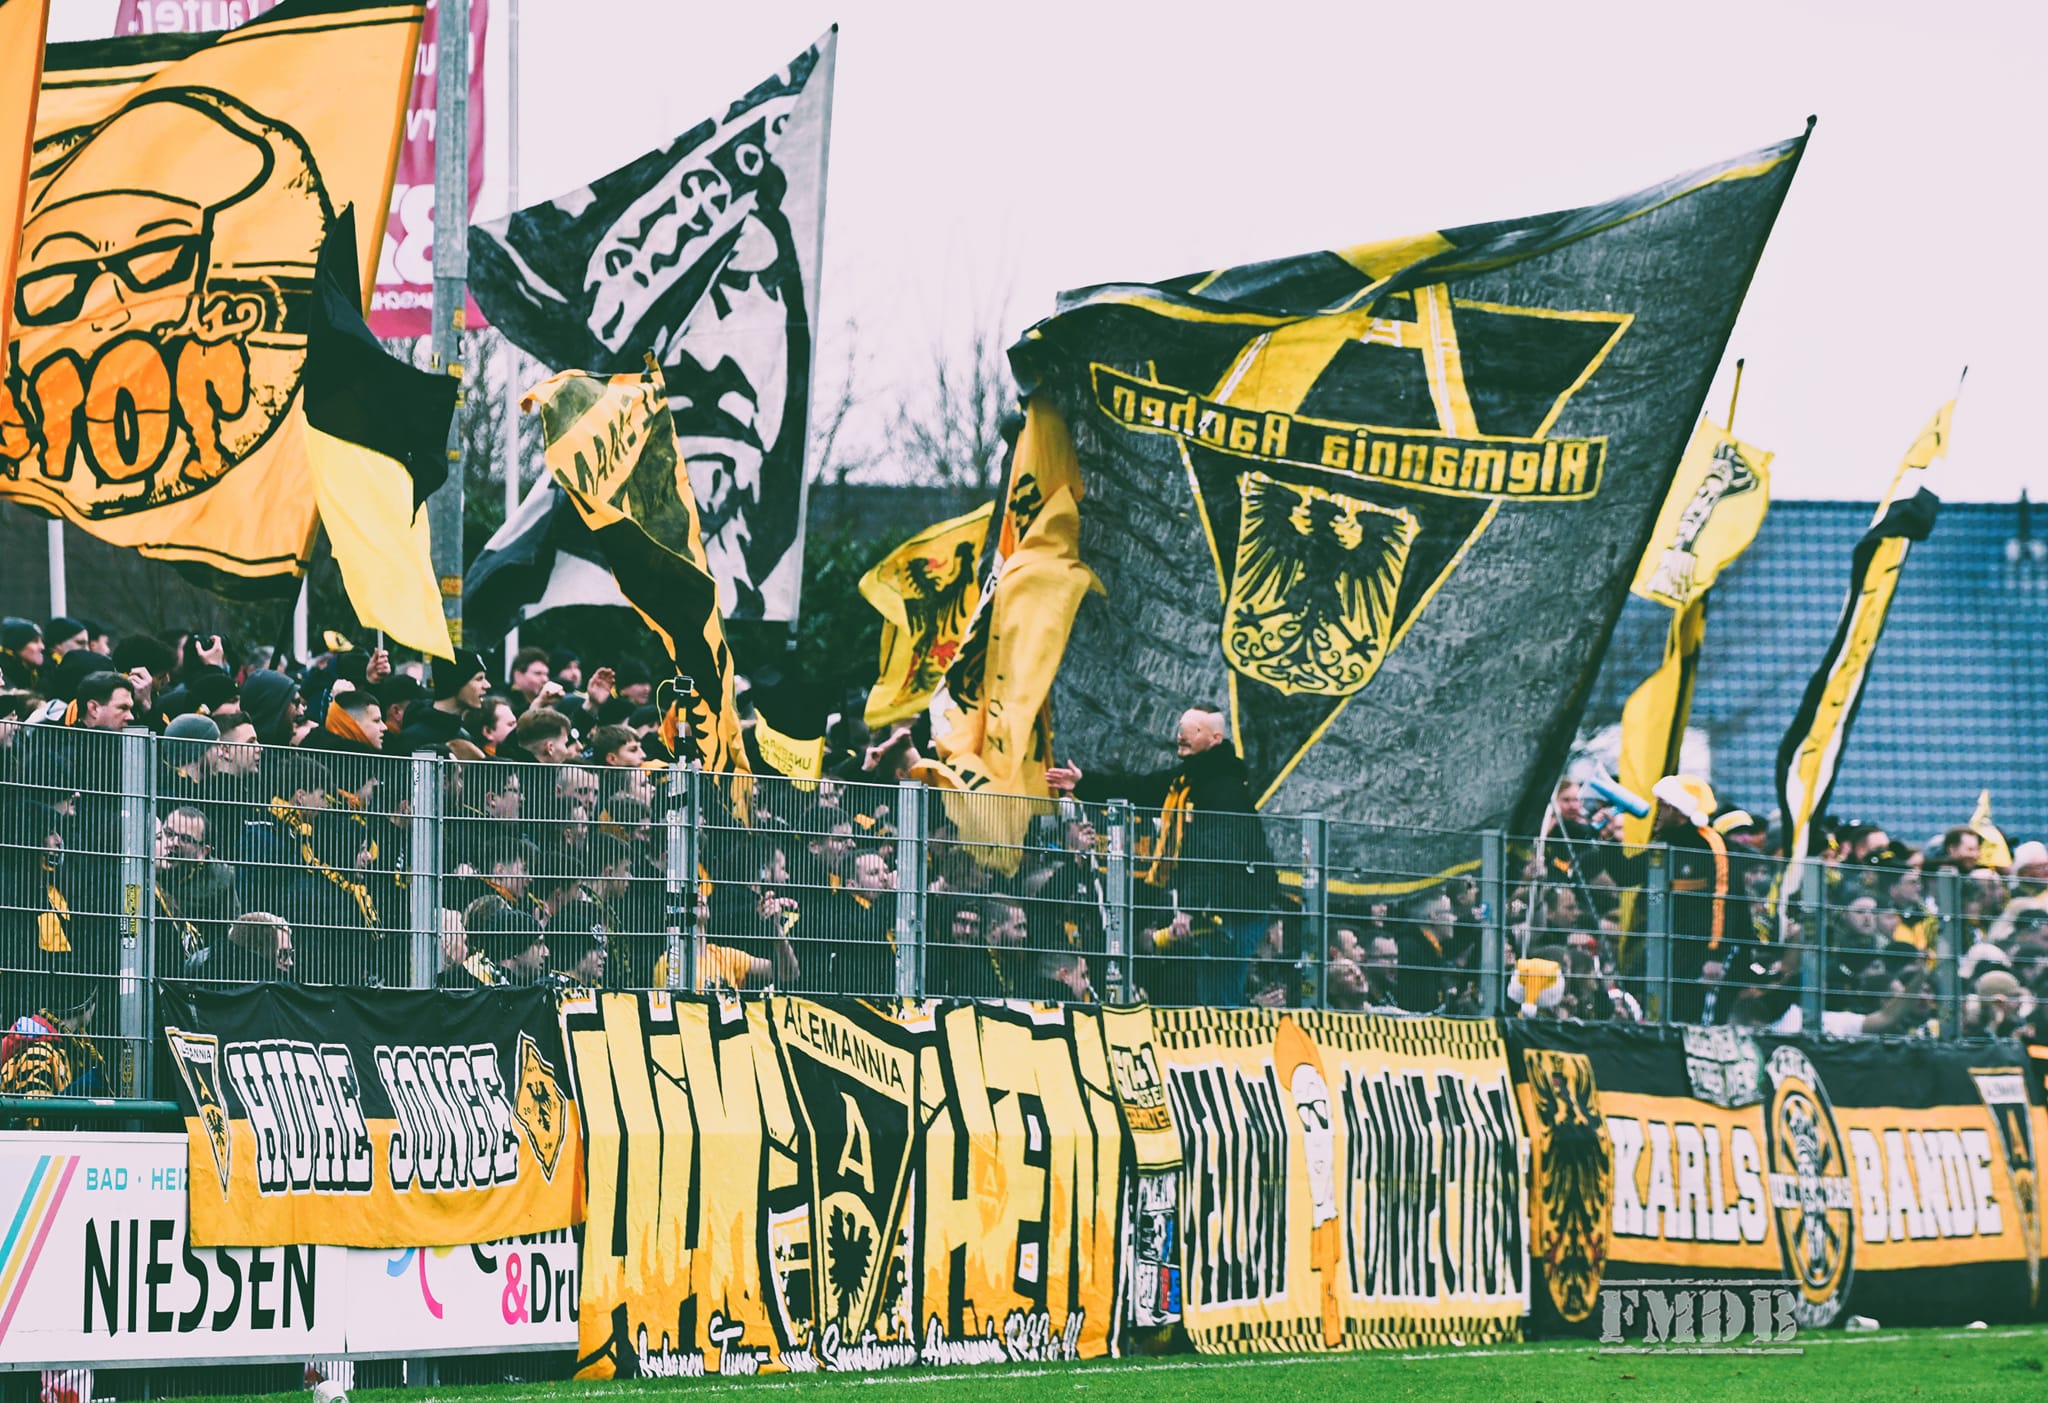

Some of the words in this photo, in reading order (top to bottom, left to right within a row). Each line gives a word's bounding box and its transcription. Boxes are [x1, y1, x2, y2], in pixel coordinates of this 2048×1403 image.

[784, 1002, 906, 1094] ALEMANNIA
[226, 1043, 373, 1193] HURE
[377, 1049, 519, 1191] JONGE
[837, 1092, 875, 1194] A
[86, 1167, 128, 1191] BAD
[1606, 1116, 1768, 1242] KARLS
[1850, 1129, 2003, 1241] BANDE
[83, 1218, 317, 1337] NIESSEN
